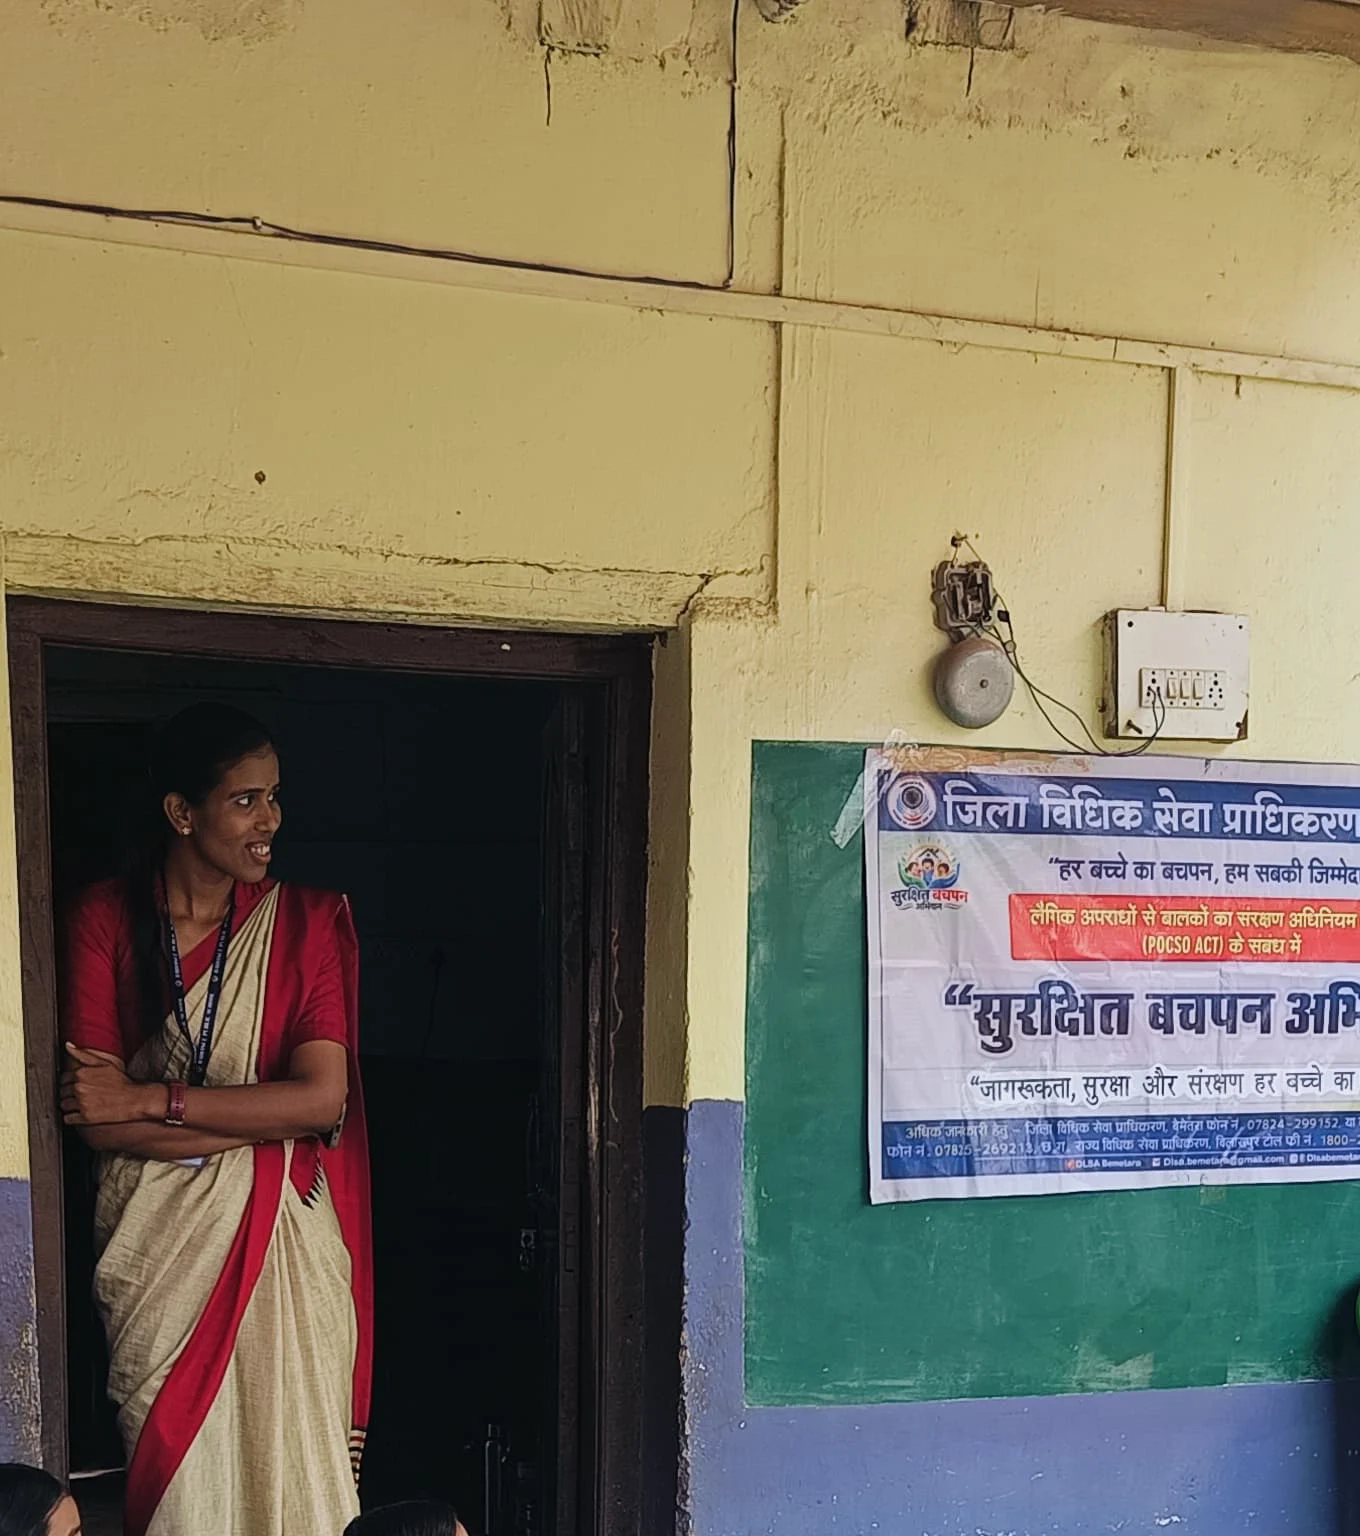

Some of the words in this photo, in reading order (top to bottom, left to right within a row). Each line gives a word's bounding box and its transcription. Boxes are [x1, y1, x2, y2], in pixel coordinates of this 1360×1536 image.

[943, 780, 1029, 829] जिला
[1040, 783, 1143, 830] विधिक
[1152, 787, 1213, 835] सेवा
[1090, 852, 1128, 880] बच्चे
[1132, 861, 1156, 880] का
[1160, 861, 1218, 885] बचपन,
[1223, 863, 1249, 884] हम
[1254, 857, 1303, 883] सबकी
[891, 885, 929, 906] सुरक्षित
[1081, 903, 1138, 926] अपराधों
[1142, 904, 1155, 926] से
[1160, 904, 1209, 927] बालकों
[1213, 911, 1233, 927] का
[1237, 906, 1285, 927] संरक्षण
[1289, 907, 1357, 928] अधिनियम
[1142, 935, 1190, 956] (POCSO
[1194, 935, 1224, 956] ACT)
[1228, 932, 1244, 954] के
[1288, 933, 1302, 955] में
[945, 980, 1134, 1053] “सुरक्षित
[1146, 993, 1276, 1036] बचपन
[1083, 1075, 1131, 1106] सुरक्षा
[1143, 1067, 1178, 1098] और
[1188, 1069, 1244, 1095] संरक्षण
[1255, 1073, 1277, 1094] हर
[1286, 1065, 1323, 1092] बच्चे
[1334, 1071, 1355, 1091] का
[1057, 1120, 1089, 1134] विधिक
[886, 1143, 912, 1158] फोन
[1102, 1136, 1134, 1152] विधिक
